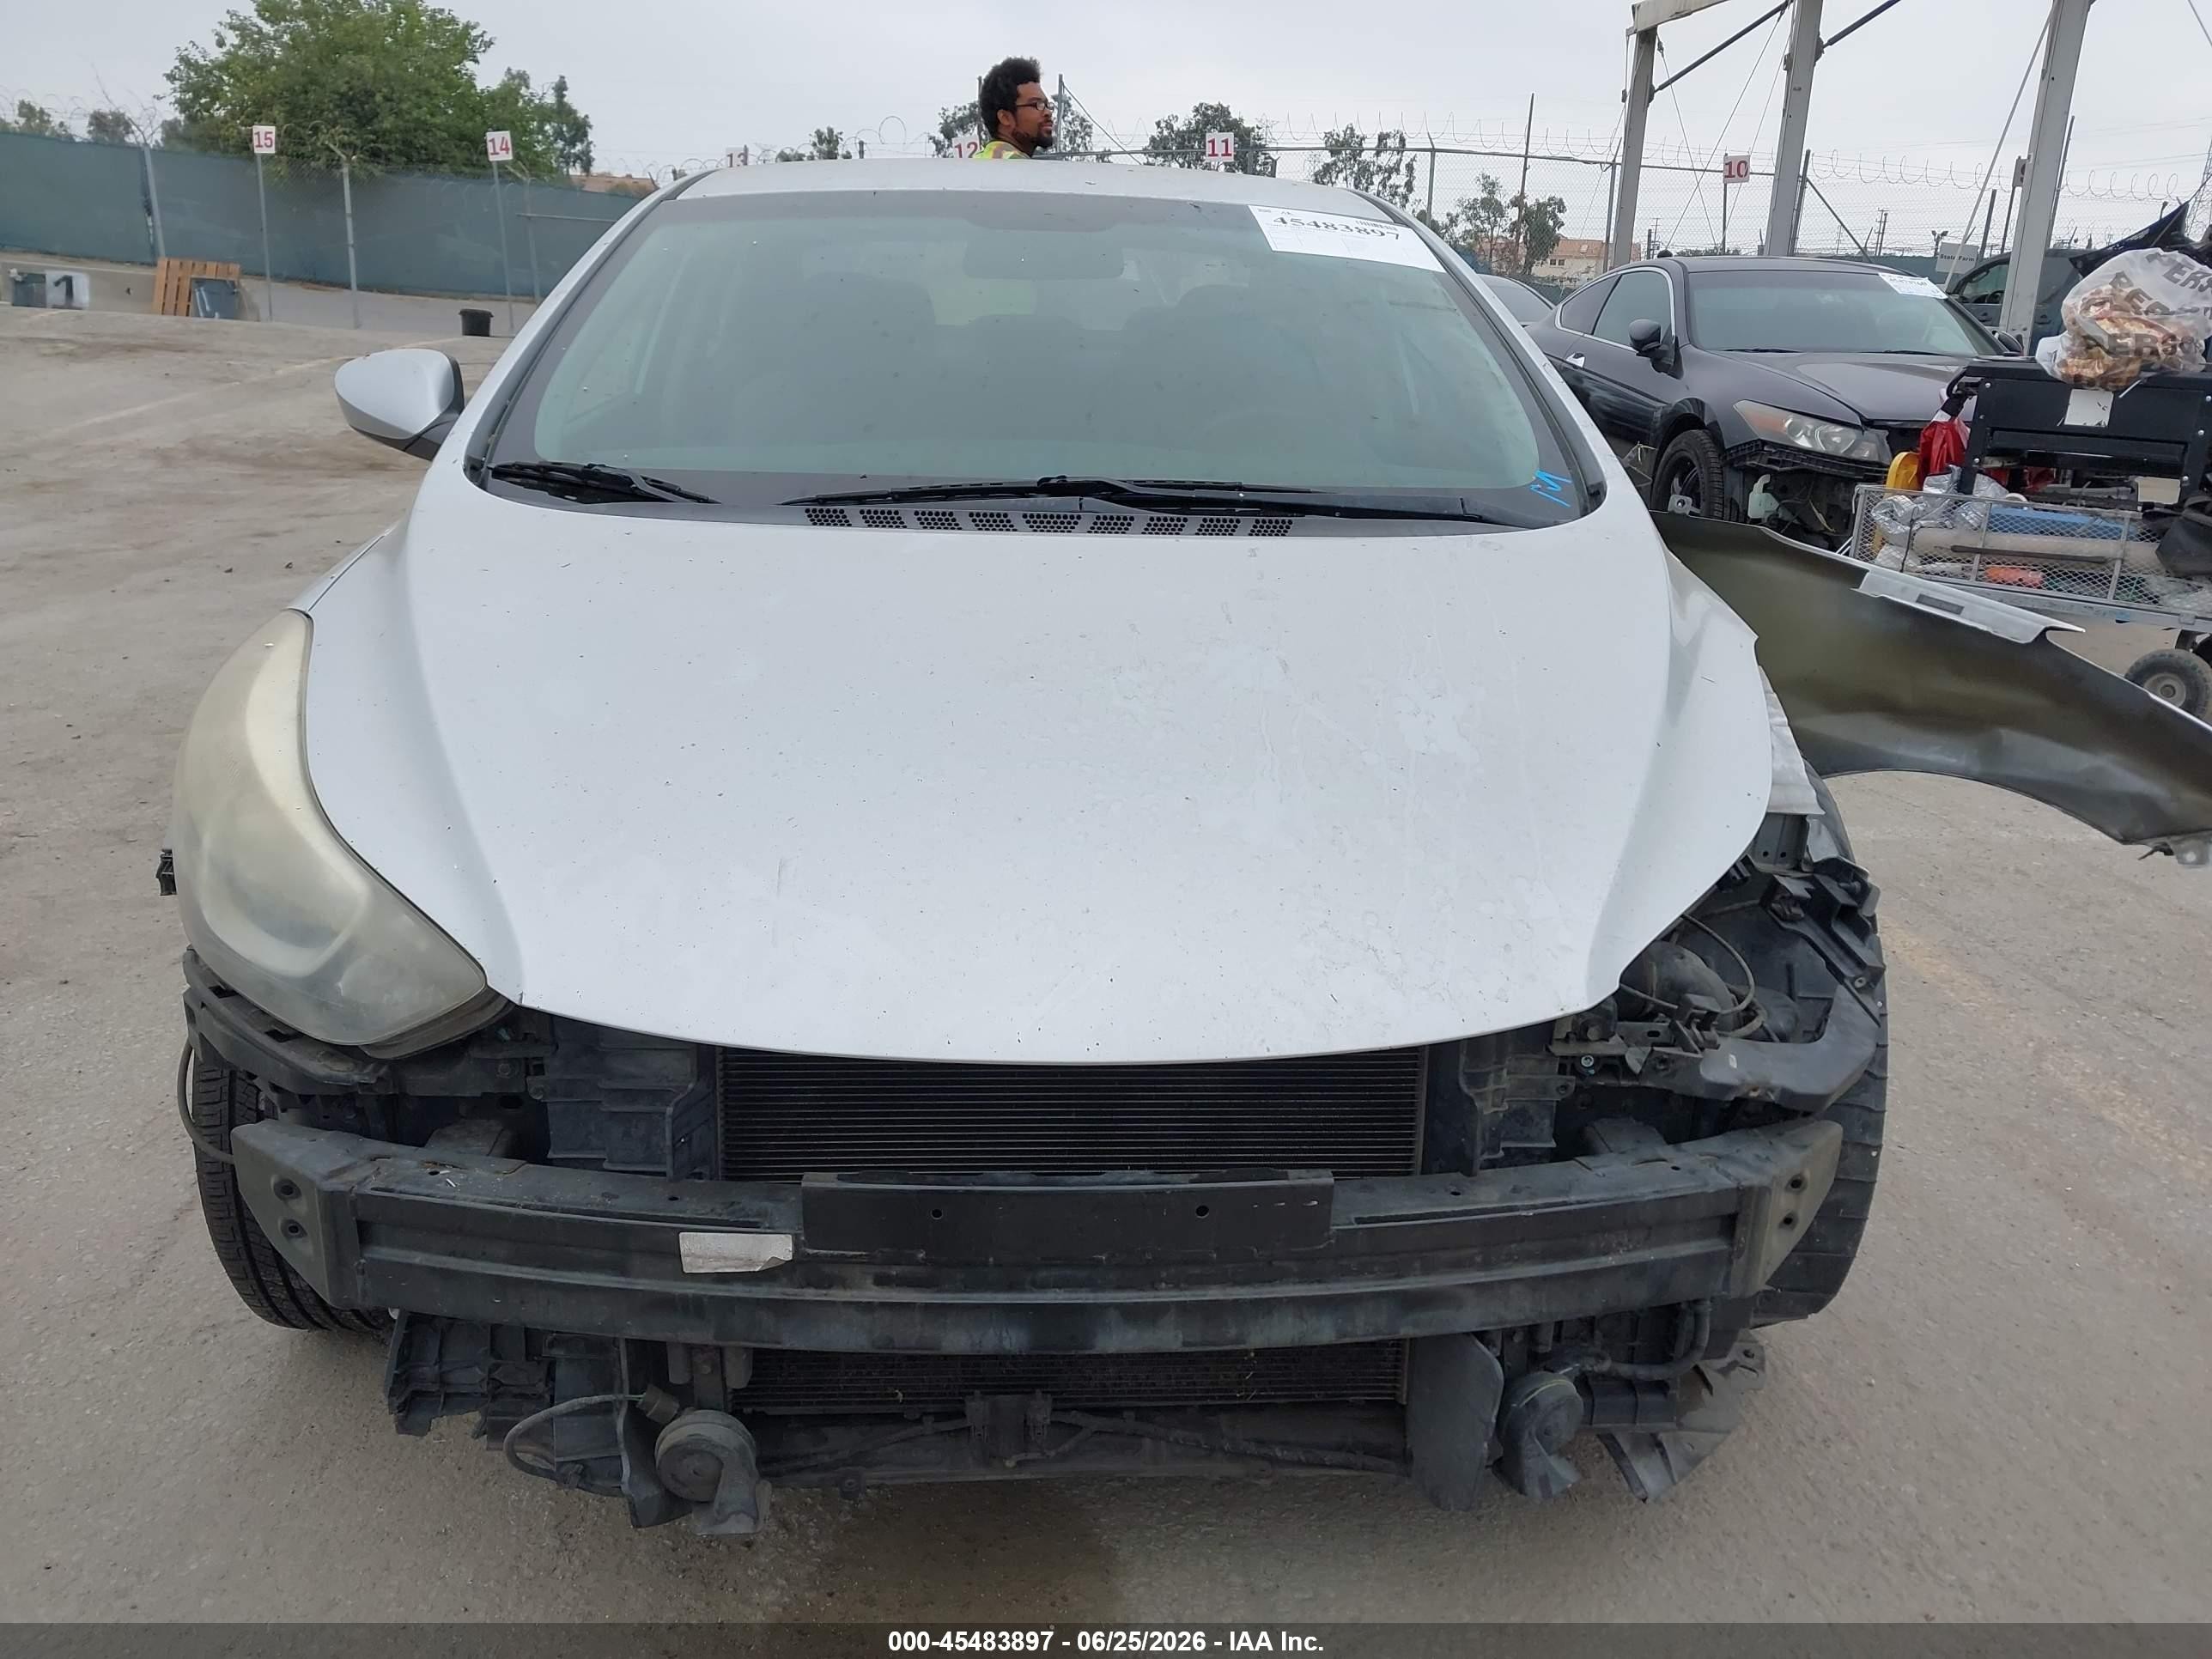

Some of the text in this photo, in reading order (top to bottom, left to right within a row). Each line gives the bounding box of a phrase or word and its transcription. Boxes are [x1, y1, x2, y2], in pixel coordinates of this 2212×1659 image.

[254, 131, 274, 149] 15
[489, 136, 510, 155] 14
[1207, 137, 1232, 157] 11
[954, 142, 978, 159] 12
[1724, 160, 1748, 178] 10
[1273, 216, 1400, 240] 45483897
